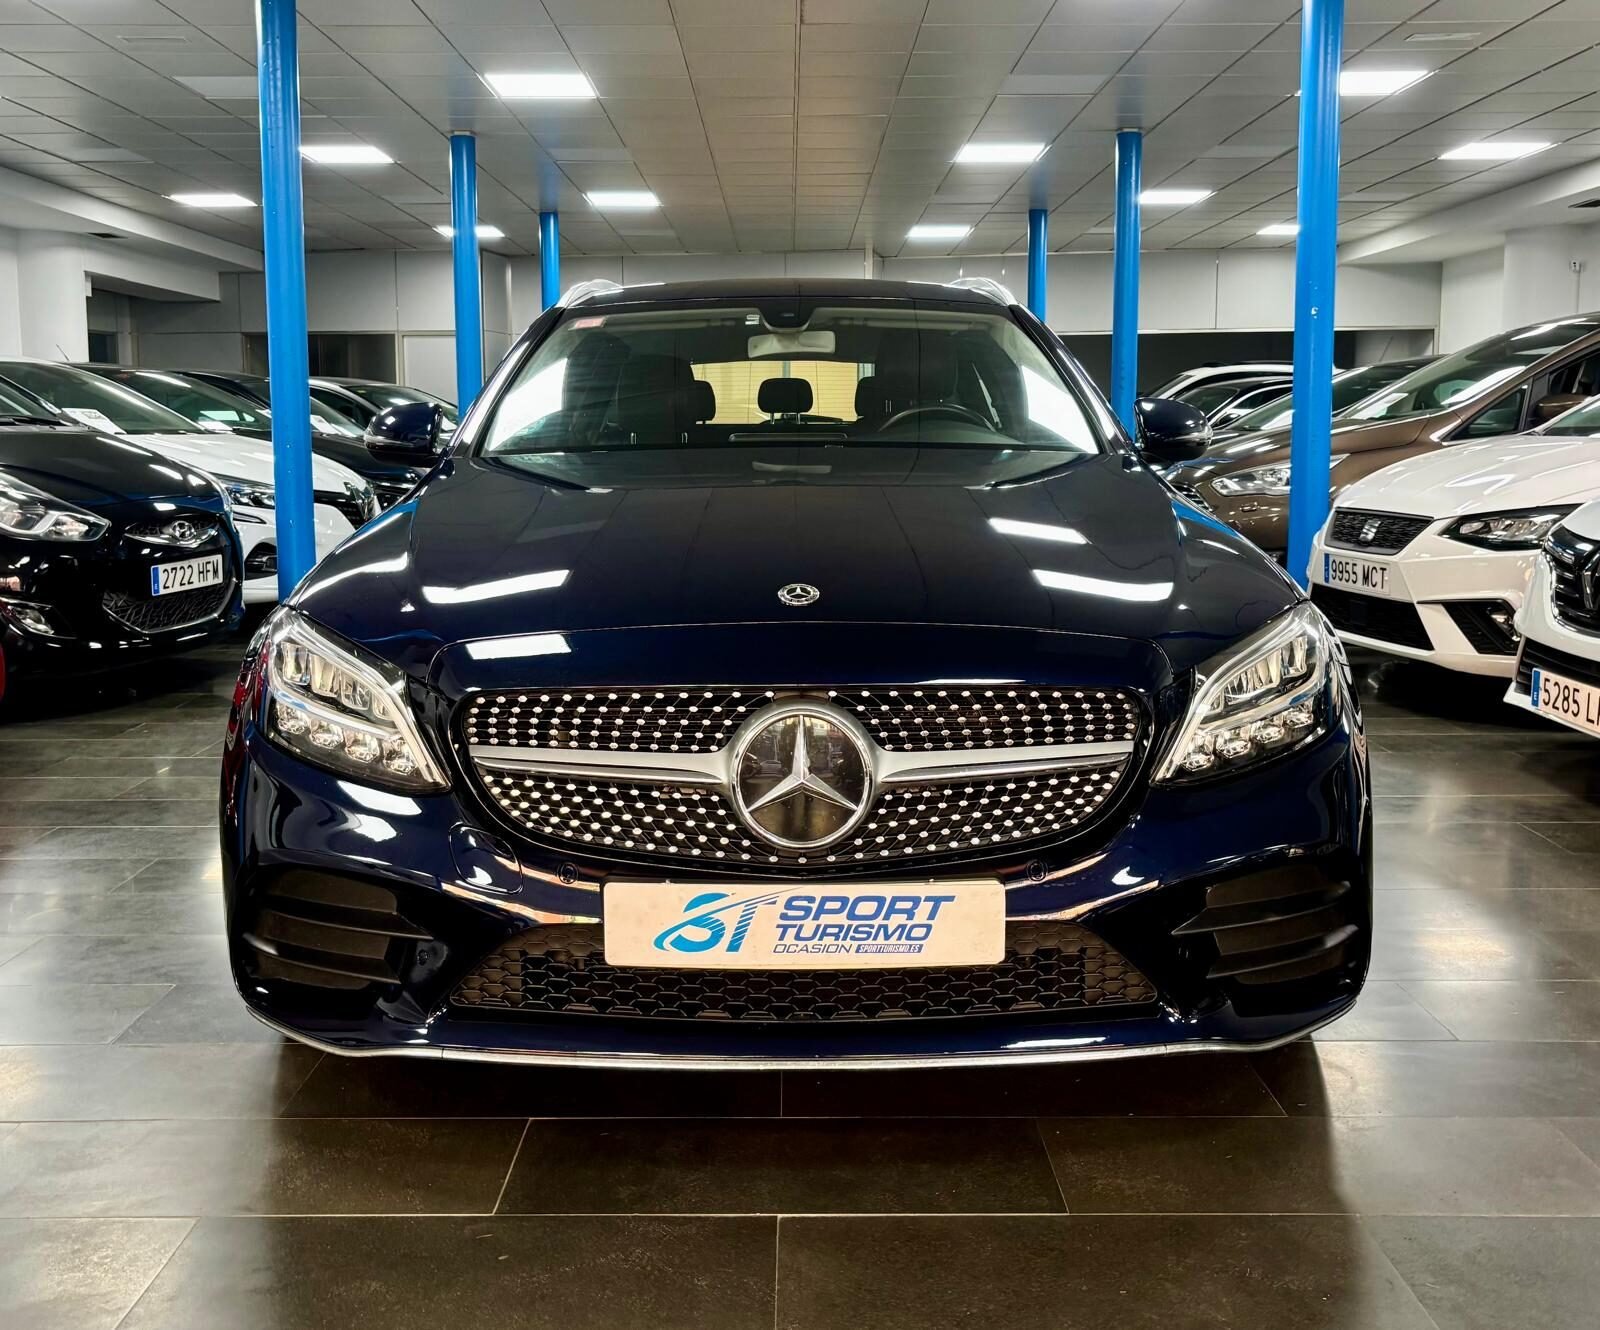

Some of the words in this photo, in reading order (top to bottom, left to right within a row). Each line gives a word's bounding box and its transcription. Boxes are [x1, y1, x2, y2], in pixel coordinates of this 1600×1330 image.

[162, 564, 194, 590] 2722
[197, 559, 219, 583] HFM
[1330, 559, 1358, 585] 9955
[1362, 564, 1387, 589] MCT
[1542, 677, 1580, 717] 5285
[1586, 691, 1600, 727] L
[779, 895, 956, 921] SPORT
[775, 923, 933, 942] TURISMO
[773, 943, 852, 954] OCASION
[858, 944, 921, 953] SPORTTURISMO.ES
